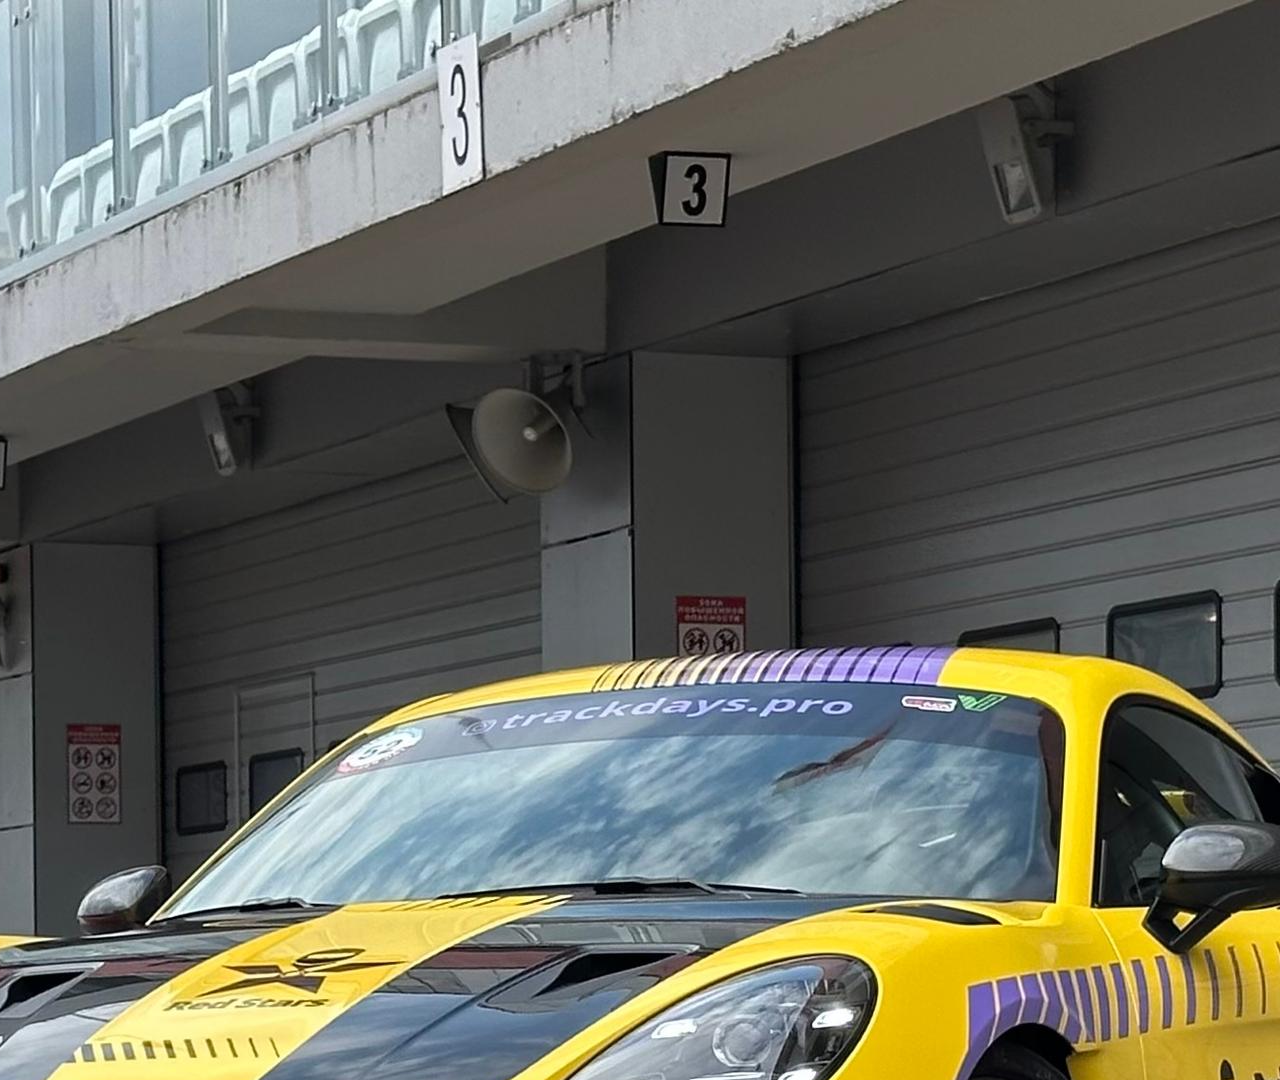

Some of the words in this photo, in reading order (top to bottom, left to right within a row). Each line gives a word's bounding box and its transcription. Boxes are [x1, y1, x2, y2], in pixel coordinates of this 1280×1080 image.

[450, 63, 469, 166] 3
[682, 163, 707, 216] 3
[502, 697, 854, 731] trackdays.pro
[163, 999, 235, 1012] Red
[234, 998, 329, 1009] Stars
